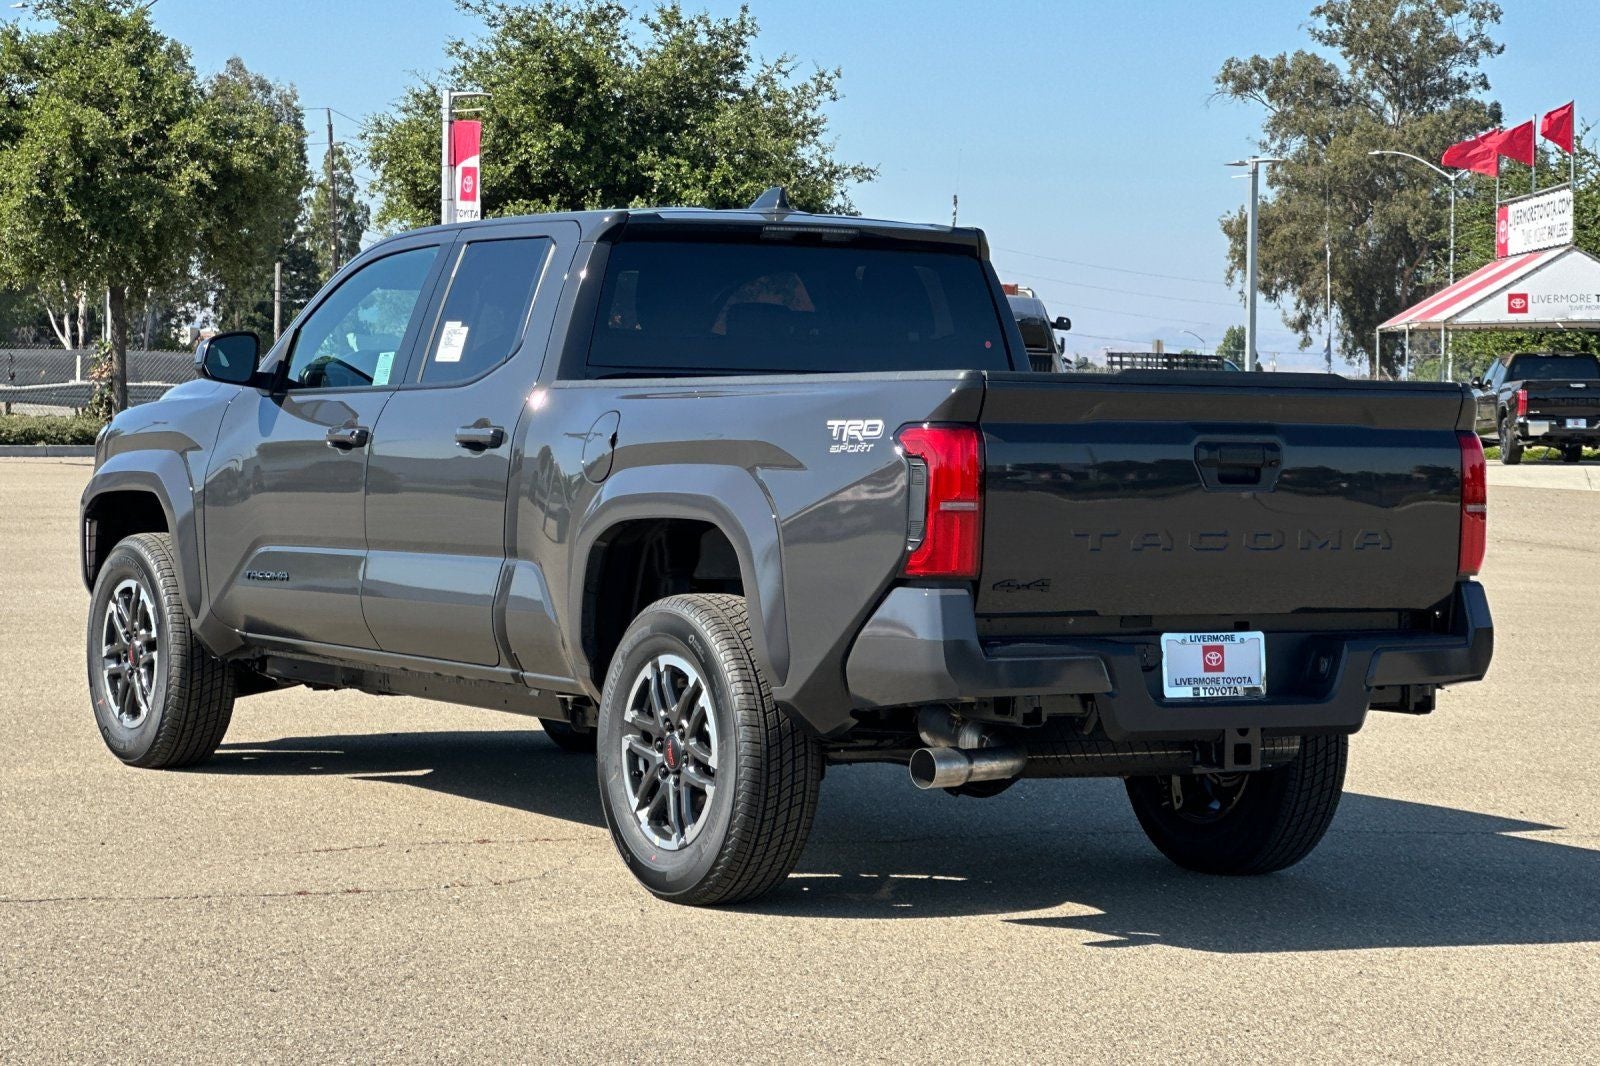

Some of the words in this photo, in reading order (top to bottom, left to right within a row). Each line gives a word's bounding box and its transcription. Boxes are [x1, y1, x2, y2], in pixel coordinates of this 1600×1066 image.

[1531, 293, 1592, 304] LIVERMORE
[826, 419, 885, 442] TRD
[829, 442, 875, 453] SPORT
[1071, 529, 1393, 551] TACOMA
[1189, 634, 1236, 643] LIVERMORE
[1175, 677, 1220, 686] LIVERMORE
[1221, 676, 1253, 685] TOYOTA
[1202, 686, 1239, 696] TOYOTA
